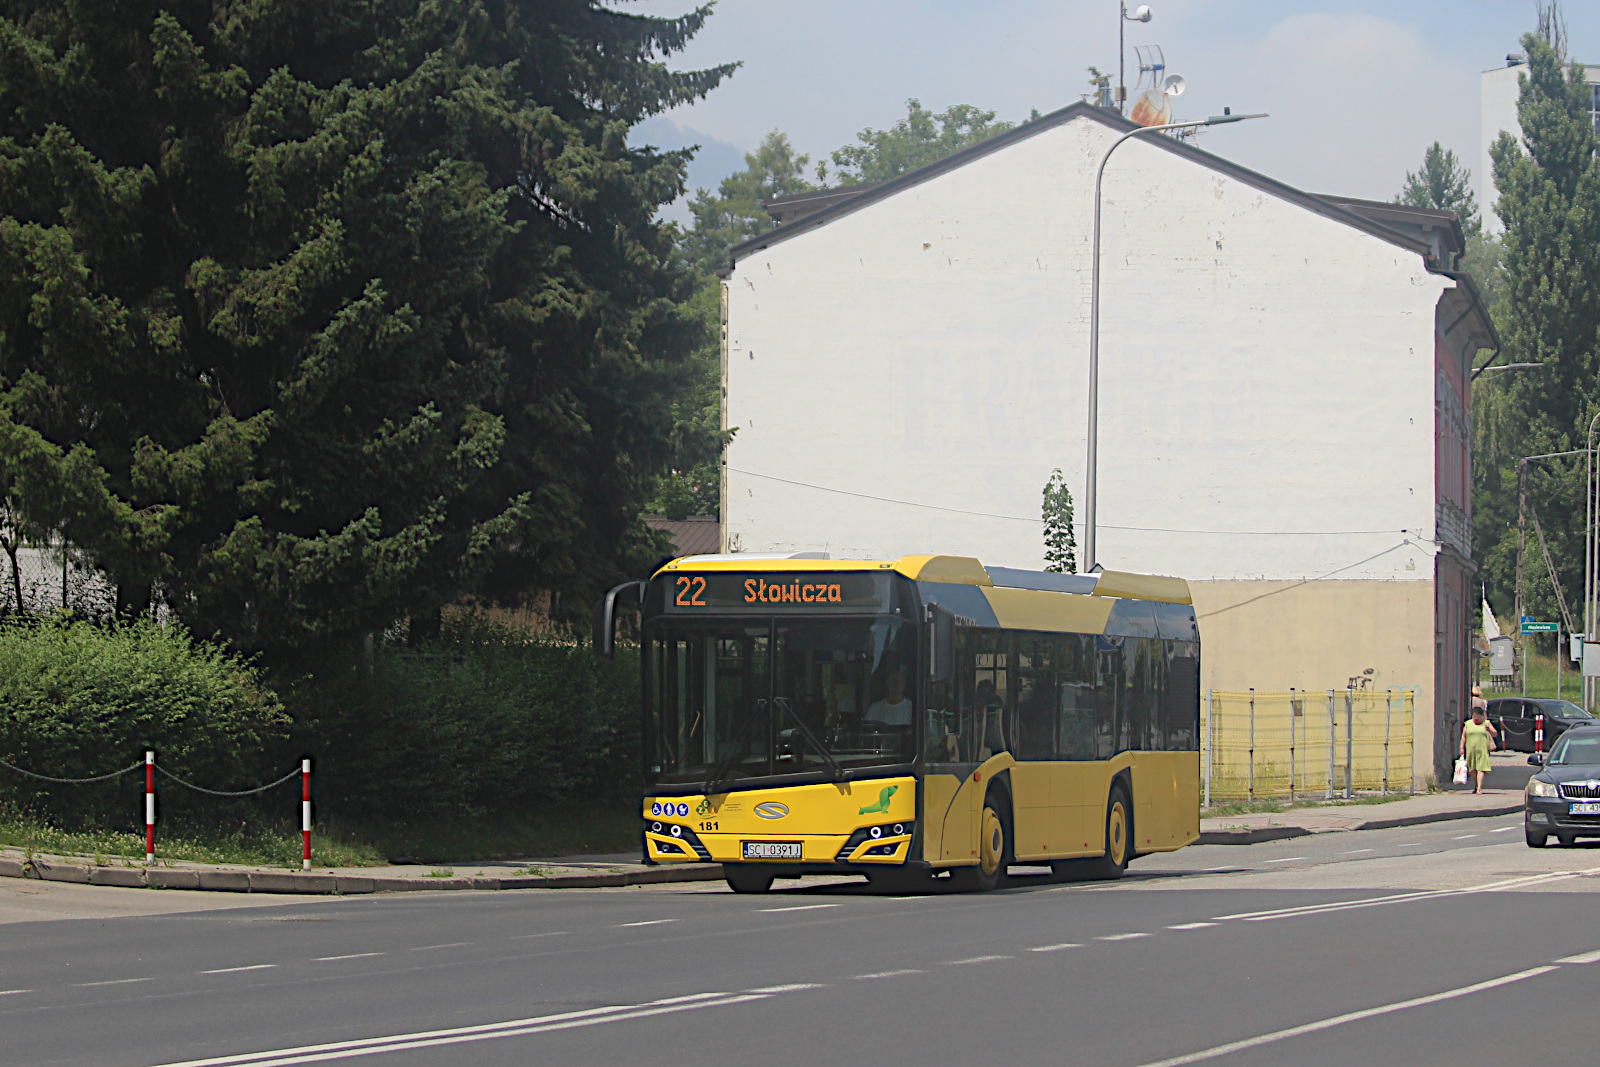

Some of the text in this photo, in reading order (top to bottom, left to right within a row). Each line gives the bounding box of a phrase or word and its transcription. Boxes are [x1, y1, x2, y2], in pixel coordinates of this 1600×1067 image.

[676, 576, 842, 606] 22 Słowicza
[699, 821, 719, 831] 181
